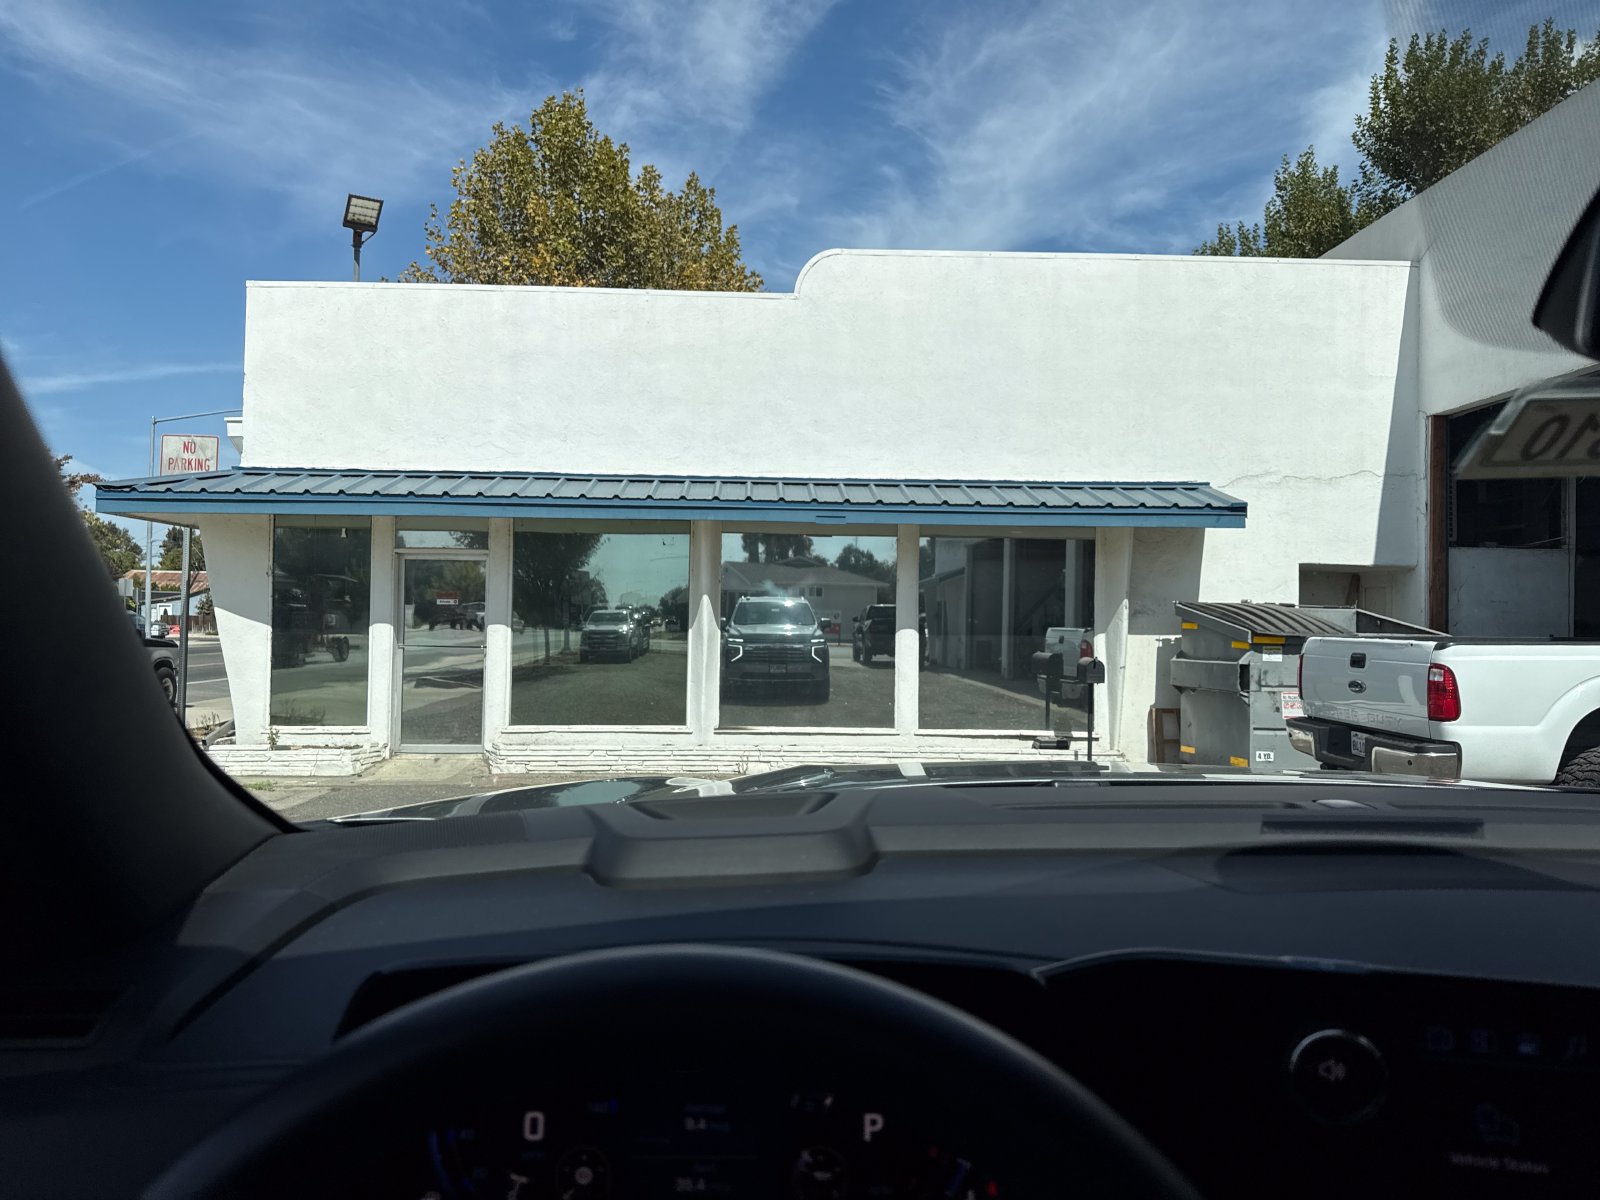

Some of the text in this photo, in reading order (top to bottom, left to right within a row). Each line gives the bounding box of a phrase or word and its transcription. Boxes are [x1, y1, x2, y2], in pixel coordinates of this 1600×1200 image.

[183, 441, 196, 454] NO
[168, 458, 210, 471] PARKING
[862, 1112, 886, 1143] P
